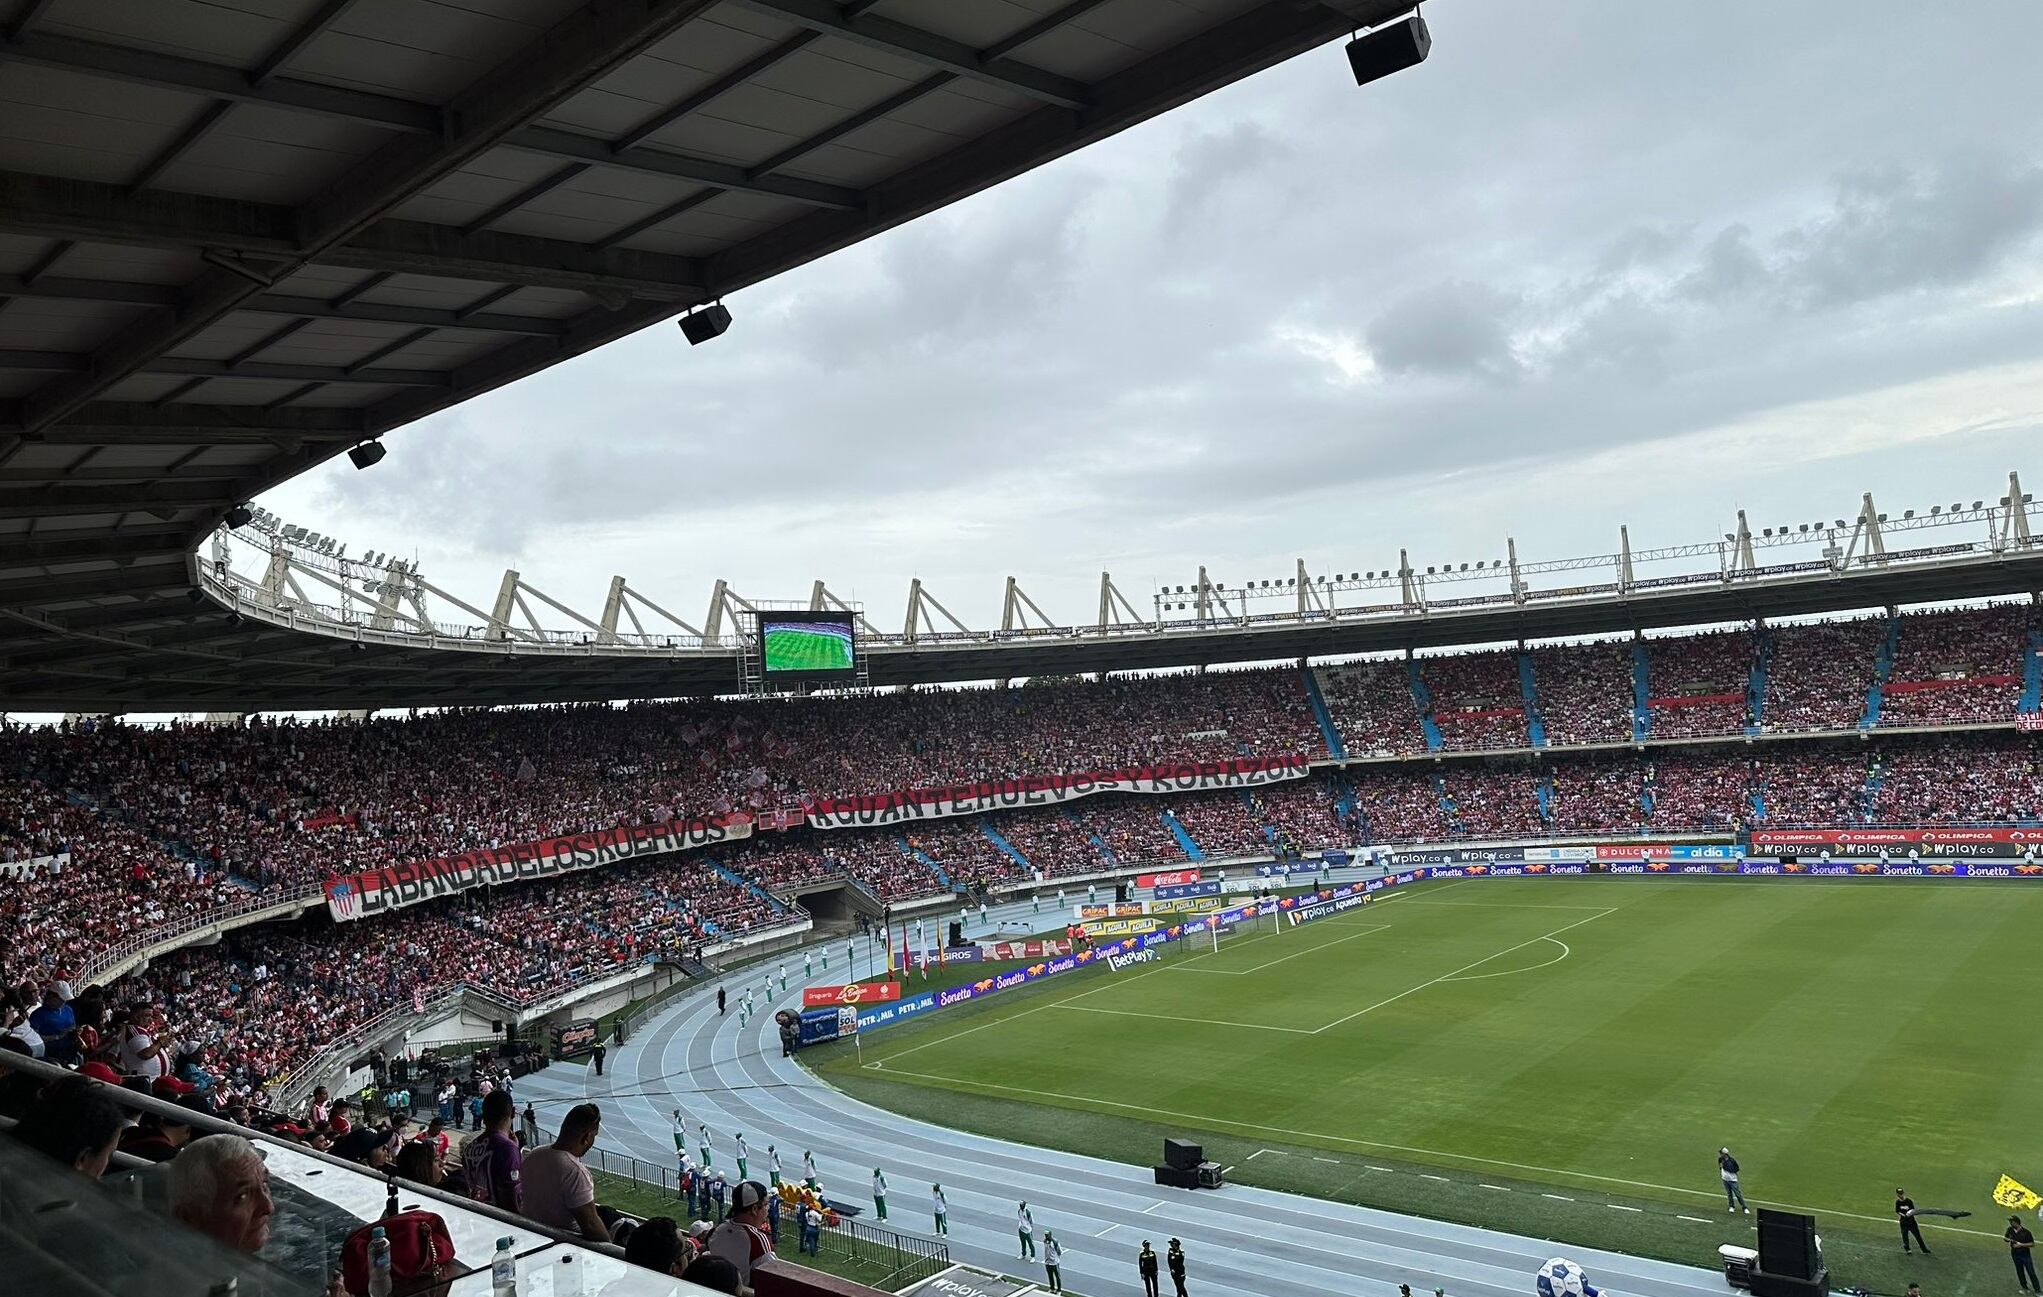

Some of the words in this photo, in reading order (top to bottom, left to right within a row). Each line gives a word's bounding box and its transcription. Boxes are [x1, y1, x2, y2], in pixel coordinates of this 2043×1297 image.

[1690, 848, 1702, 857] al
[1846, 844, 1902, 854] Wplayco
[1432, 867, 1463, 878] Sonetto
[1490, 866, 1522, 875] Sonetto
[1550, 864, 1582, 874] Sonetto
[1610, 863, 1644, 873] Sonetto
[1743, 864, 1779, 874] Sonetto
[1811, 864, 1848, 874] Sonetto
[1883, 864, 1922, 875] Sonetto
[1967, 864, 2010, 876] Sonetto
[1335, 894, 1362, 910] Apuesta
[914, 950, 972, 964] SperGIROS
[940, 988, 972, 1006] Sonetto
[996, 972, 1025, 990] Sonetto
[1048, 958, 1074, 974] Sonetto
[1095, 944, 1120, 960] Sonetto
[1143, 932, 1167, 946] Sonetto
